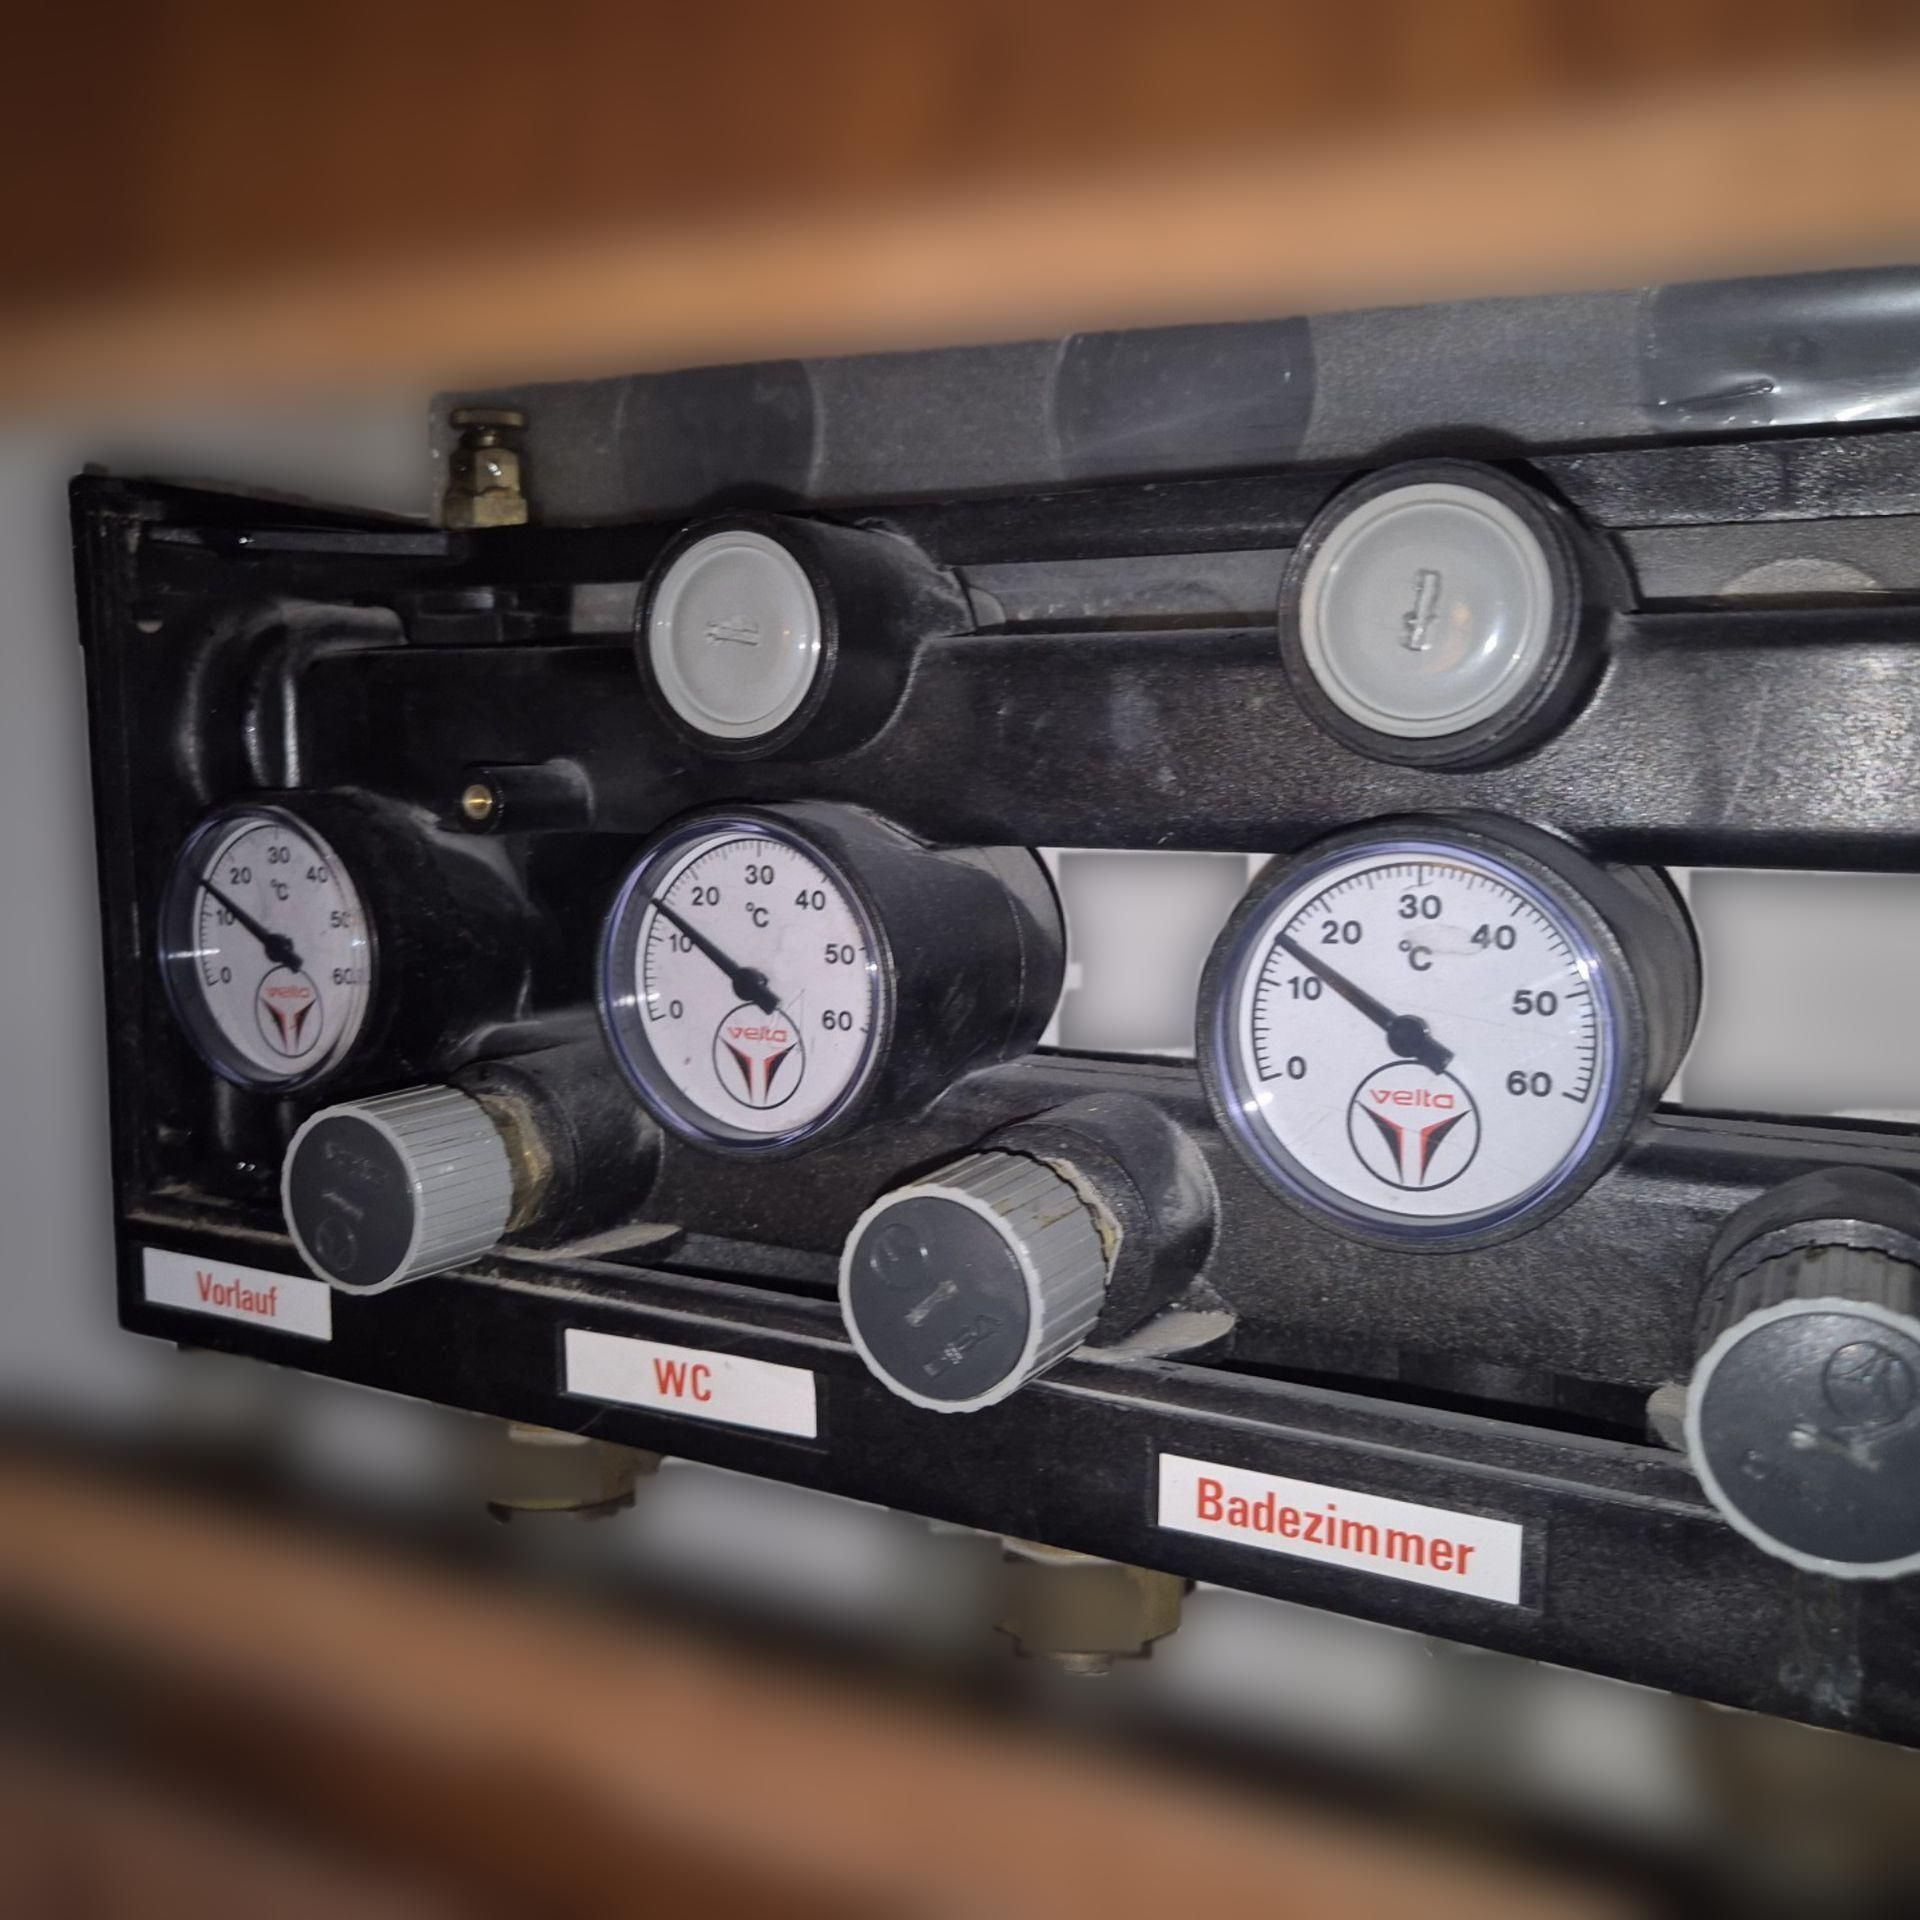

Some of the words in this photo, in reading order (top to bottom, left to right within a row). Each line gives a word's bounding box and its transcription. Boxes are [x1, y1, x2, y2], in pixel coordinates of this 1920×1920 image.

[267, 846, 290, 864] 30
[230, 866, 251, 884] 20
[306, 866, 328, 883] 40
[745, 865, 774, 885] 30
[692, 886, 719, 906] 20
[795, 890, 826, 911] 40
[216, 909, 235, 926] 10
[745, 902, 770, 928] °C
[1398, 895, 1442, 920] 30
[330, 911, 352, 928] 50
[669, 933, 694, 953] 10
[1321, 920, 1363, 945] 20
[1471, 924, 1517, 951] 40
[825, 944, 855, 965] 50
[1398, 940, 1432, 972] °C
[220, 967, 232, 984] 0
[333, 968, 357, 985] 60
[1287, 976, 1322, 1001] 10
[670, 1000, 683, 1019] 0
[1512, 990, 1558, 1017] 50
[822, 1010, 853, 1031] 60
[728, 1026, 787, 1043] velta
[1287, 1056, 1307, 1080] 0
[1506, 1070, 1552, 1097] 60
[1370, 1088, 1455, 1109] velta
[196, 1270, 278, 1318] Vorlauf
[654, 1358, 712, 1402] WC
[1196, 1476, 1475, 1575] Badezimmer
